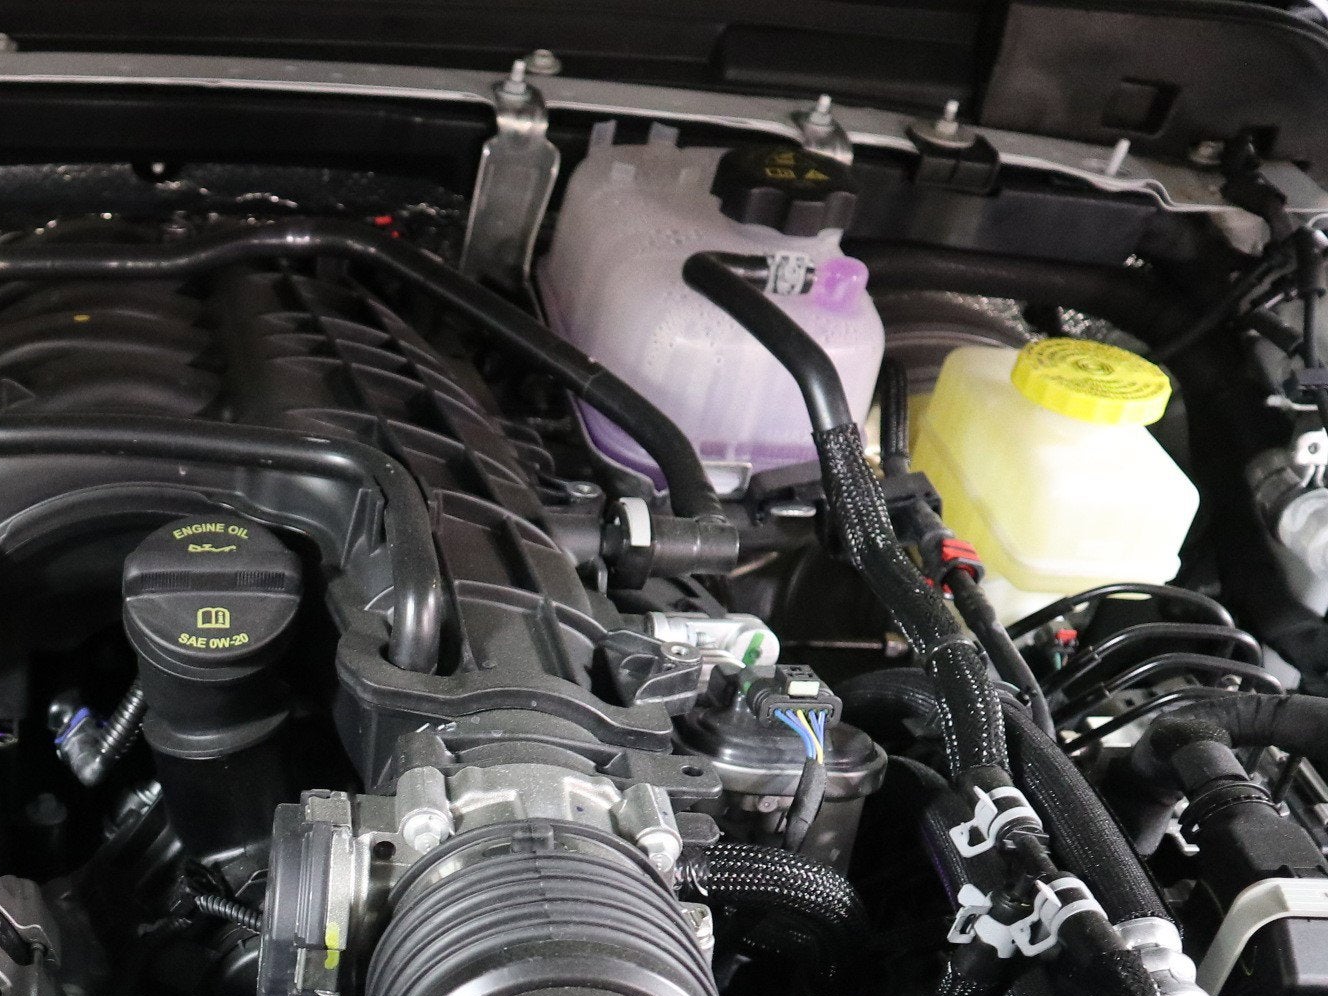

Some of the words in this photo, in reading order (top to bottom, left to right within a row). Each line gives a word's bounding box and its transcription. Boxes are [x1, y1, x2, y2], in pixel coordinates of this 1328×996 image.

[173, 522, 225, 540] ENGINE
[228, 525, 249, 539] OIL
[178, 632, 207, 648] SAE
[209, 632, 249, 649] 0W-20
